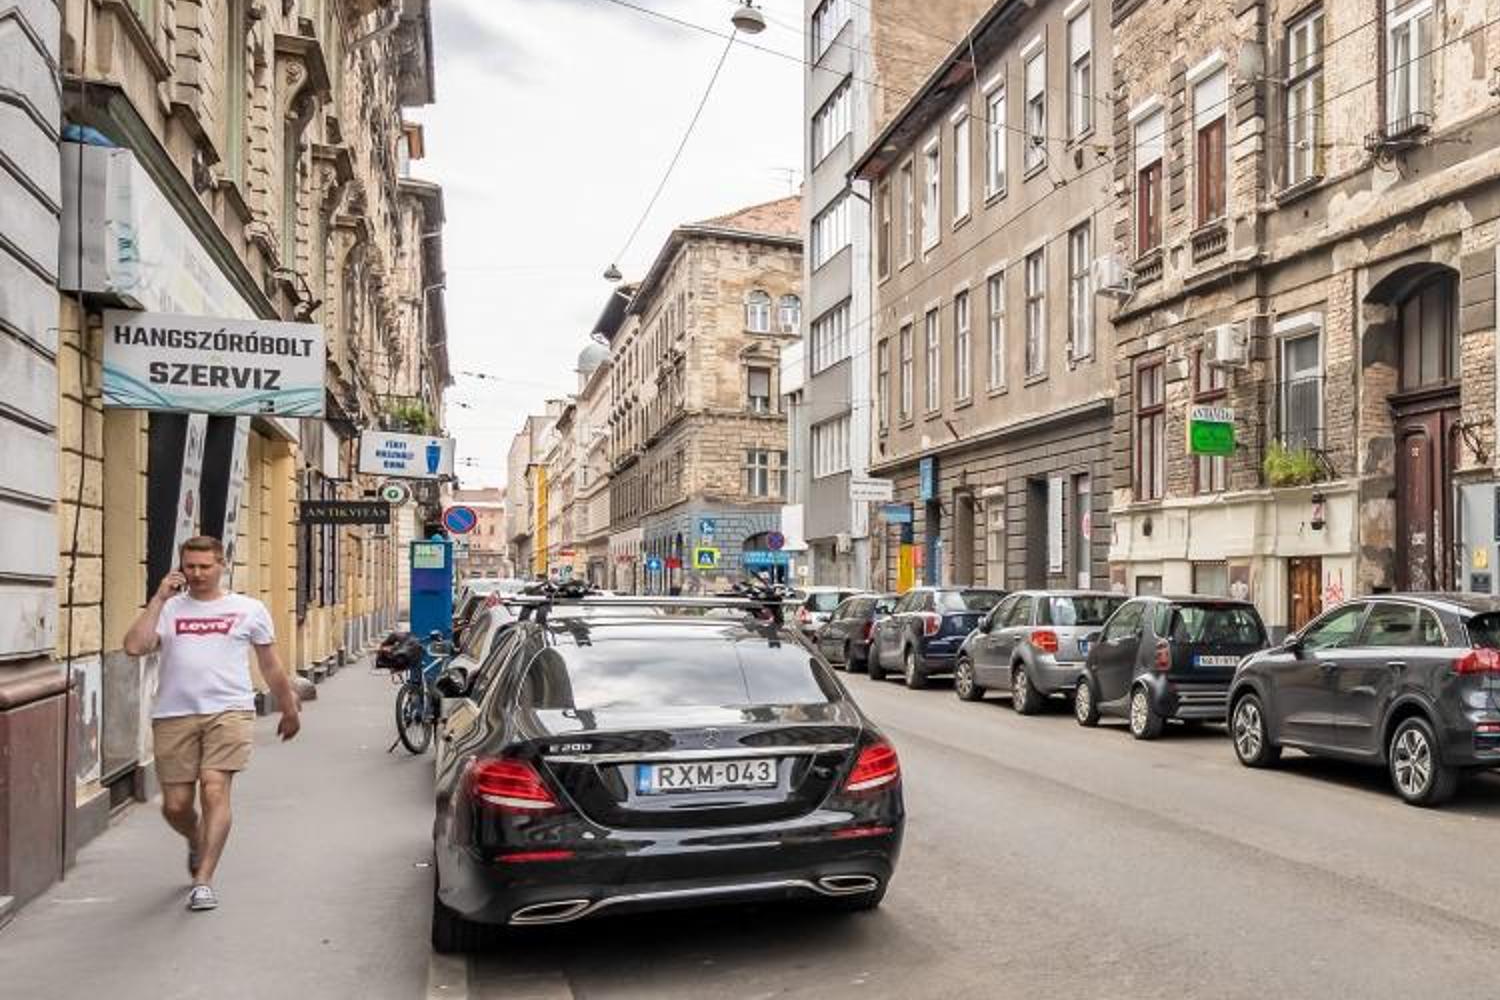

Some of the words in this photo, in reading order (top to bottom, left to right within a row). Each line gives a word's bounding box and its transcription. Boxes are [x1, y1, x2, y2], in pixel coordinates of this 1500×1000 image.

[113, 325, 315, 357] HANGSZÓRÓBOLT
[149, 361, 281, 391] SZERVIZ
[658, 760, 770, 787] RXM-043
